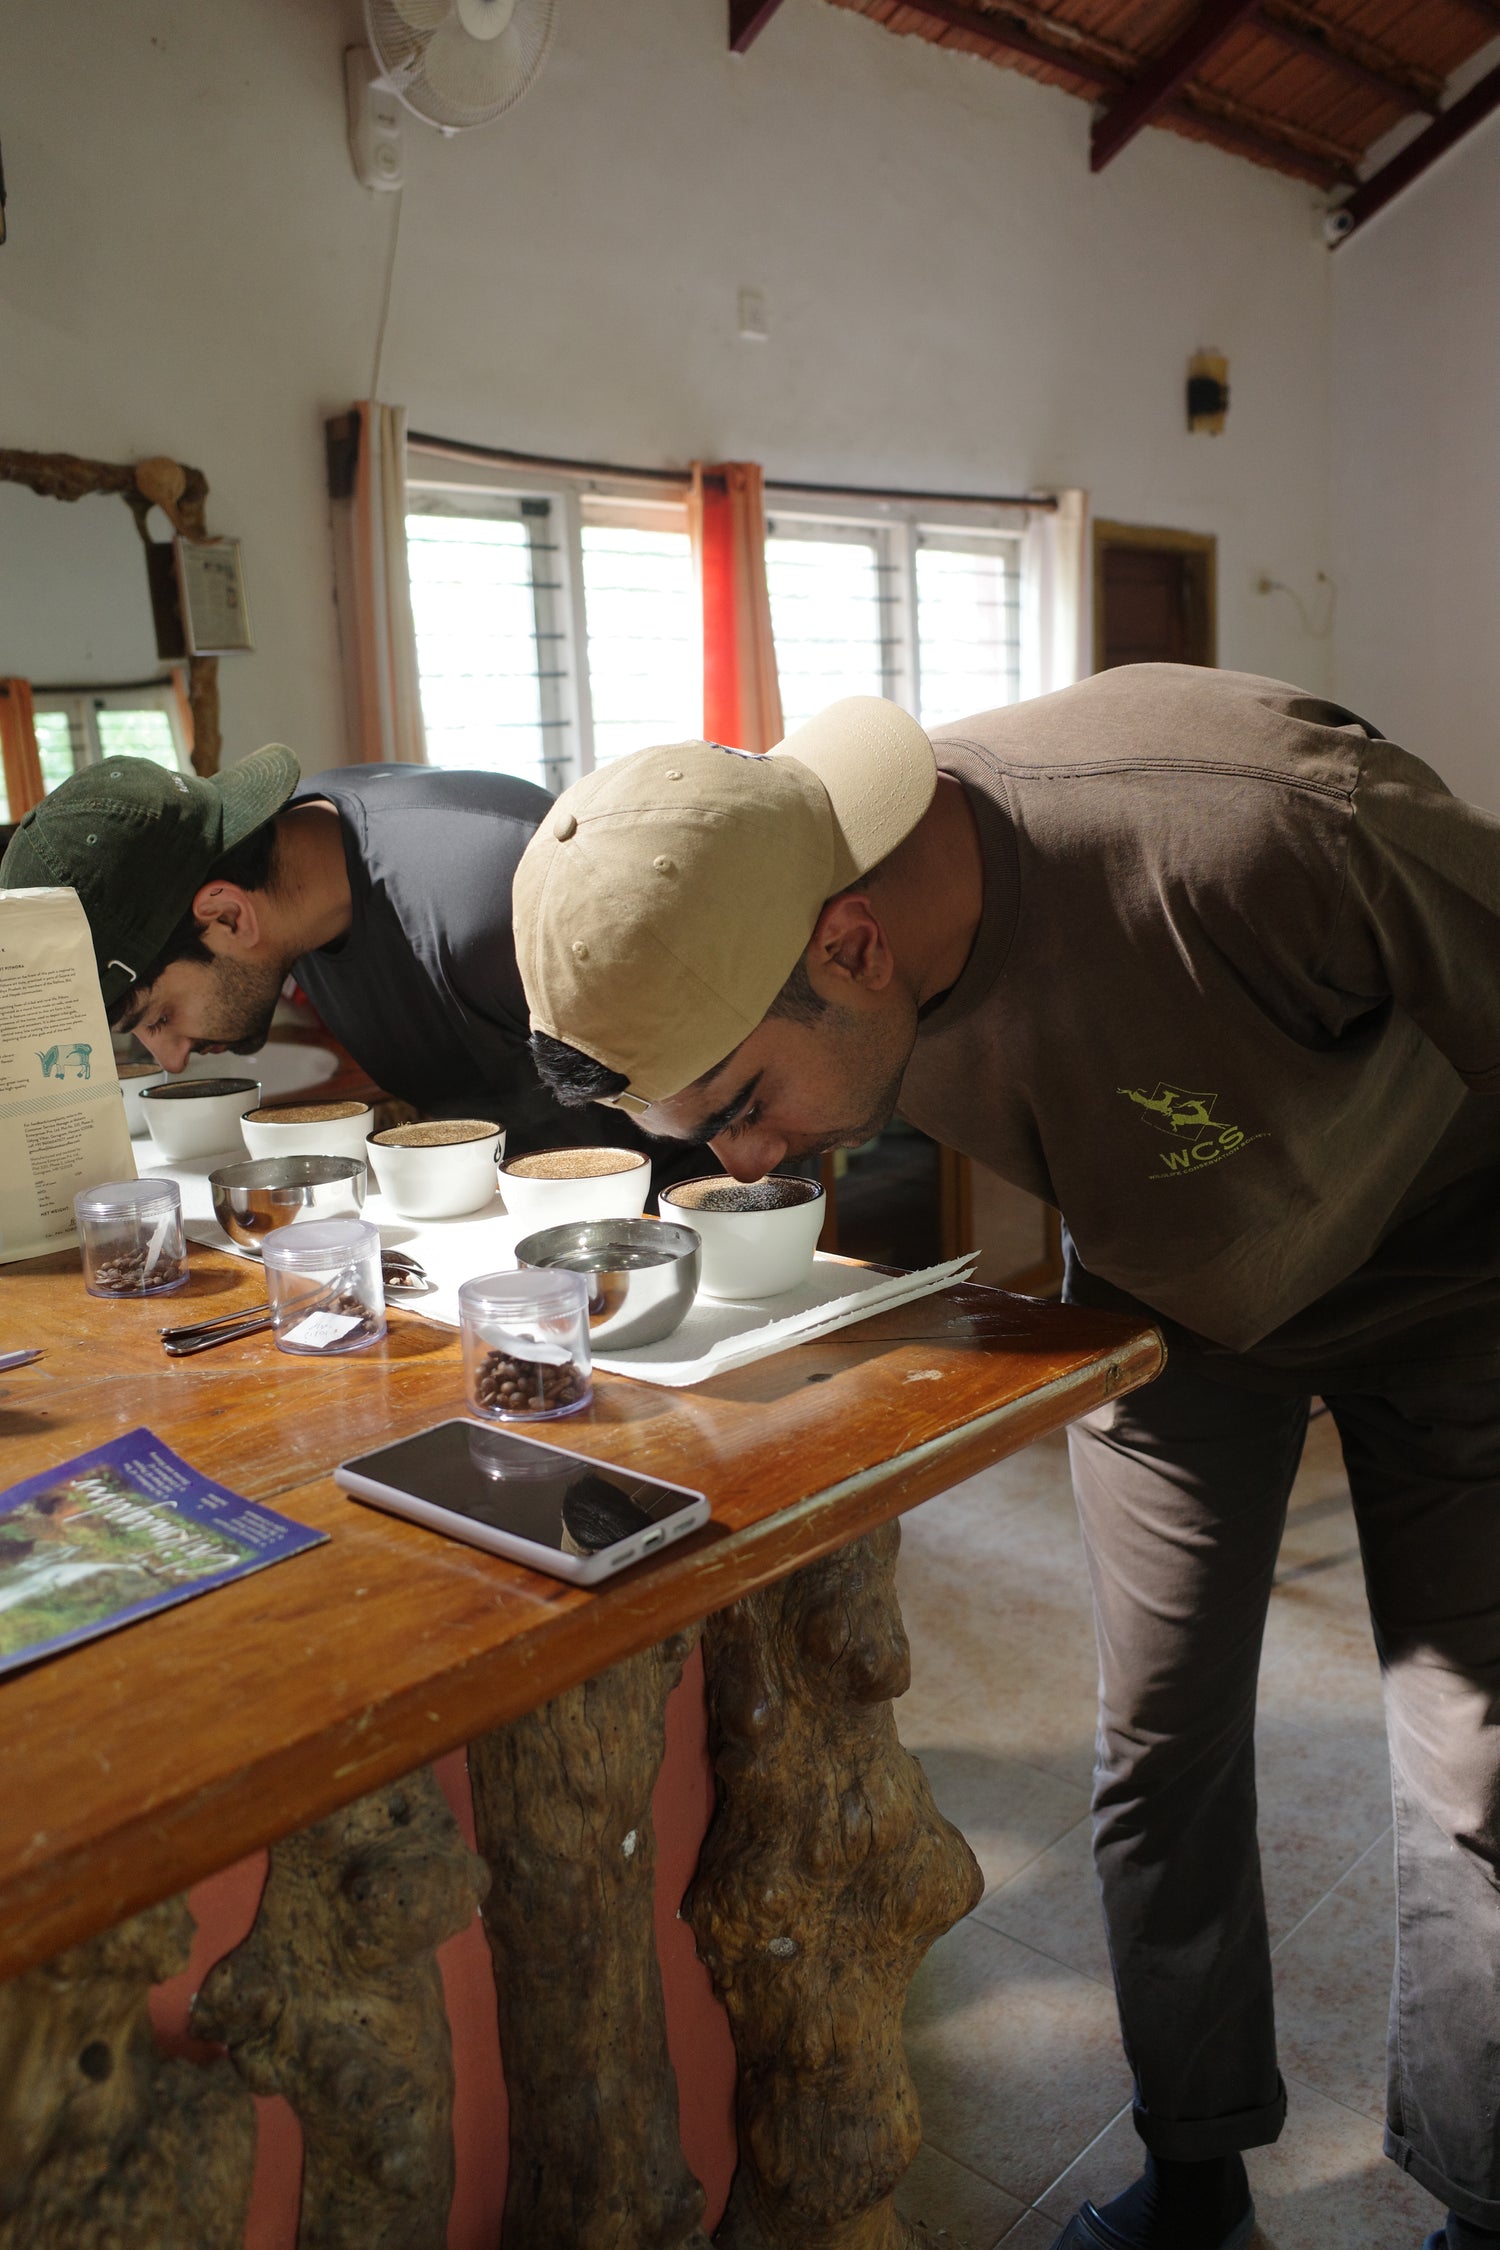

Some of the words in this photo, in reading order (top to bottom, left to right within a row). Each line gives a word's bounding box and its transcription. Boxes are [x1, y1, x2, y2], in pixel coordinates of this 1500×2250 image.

[1148, 1171, 1183, 1180] WILDLIFE
[1183, 1146, 1240, 1174] CONSERVATION
[1241, 1132, 1272, 1147] SOCIETY
[1159, 1125, 1245, 1170] WCS
